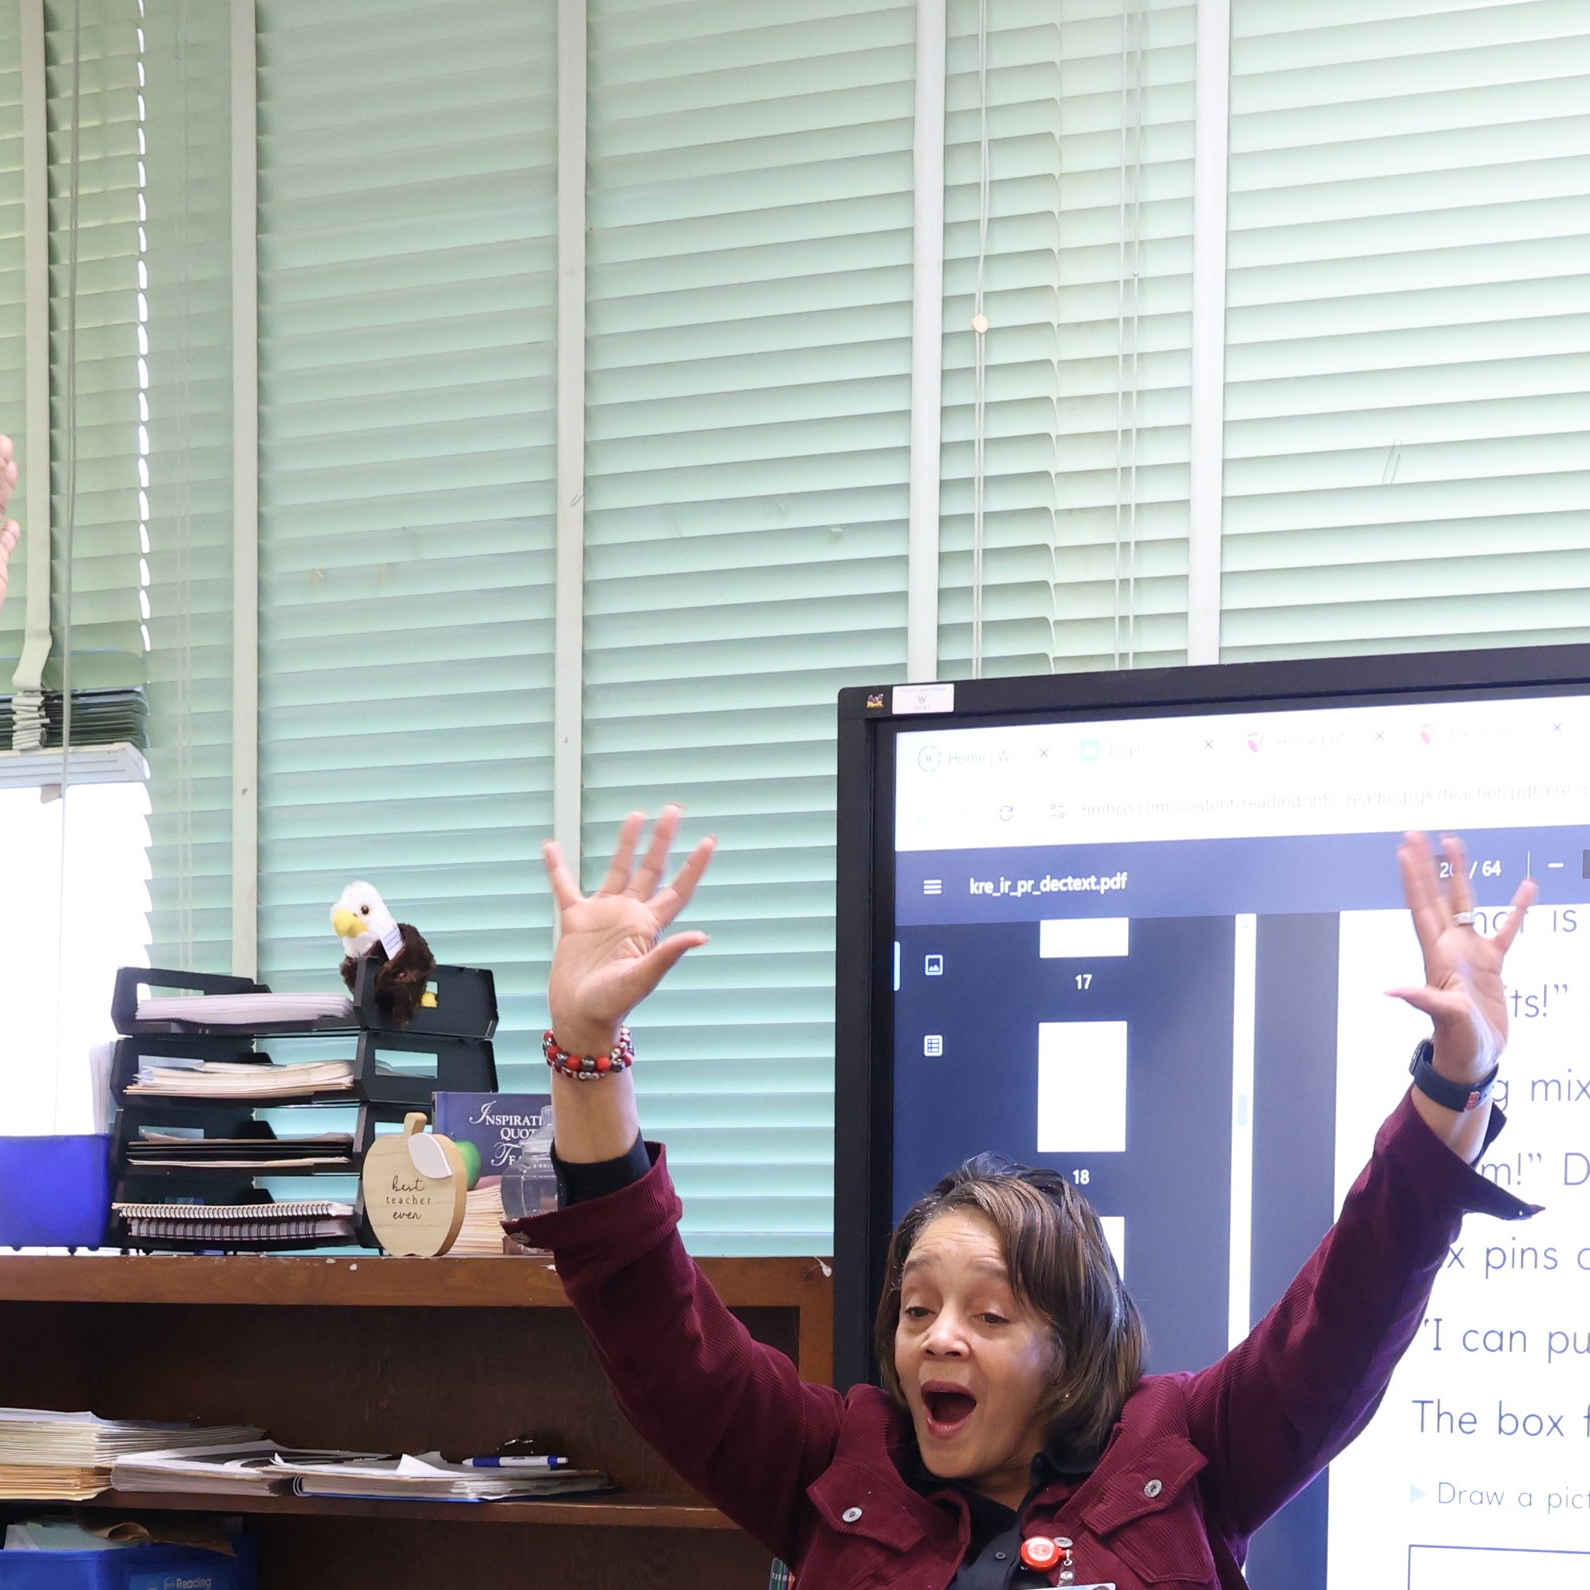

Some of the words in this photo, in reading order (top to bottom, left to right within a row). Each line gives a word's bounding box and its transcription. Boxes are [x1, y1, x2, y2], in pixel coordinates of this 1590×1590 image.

[948, 751, 987, 766] Home
[1481, 860, 1502, 877] 64
[969, 872, 1128, 897] kre_ir_pr_dectext.pdf
[1552, 908, 1578, 933] is
[1074, 973, 1093, 991] 17
[469, 1100, 542, 1126] INSPIRATI
[1072, 1168, 1090, 1185] 18
[386, 1195, 431, 1205] teacher
[1484, 1236, 1558, 1280] pins
[1461, 1328, 1527, 1353] can
[1411, 1398, 1478, 1435] The
[1497, 1400, 1565, 1438] box
[1437, 1481, 1506, 1507] Draw
[1517, 1491, 1534, 1507] a
[176, 1578, 211, 1590] Reading
